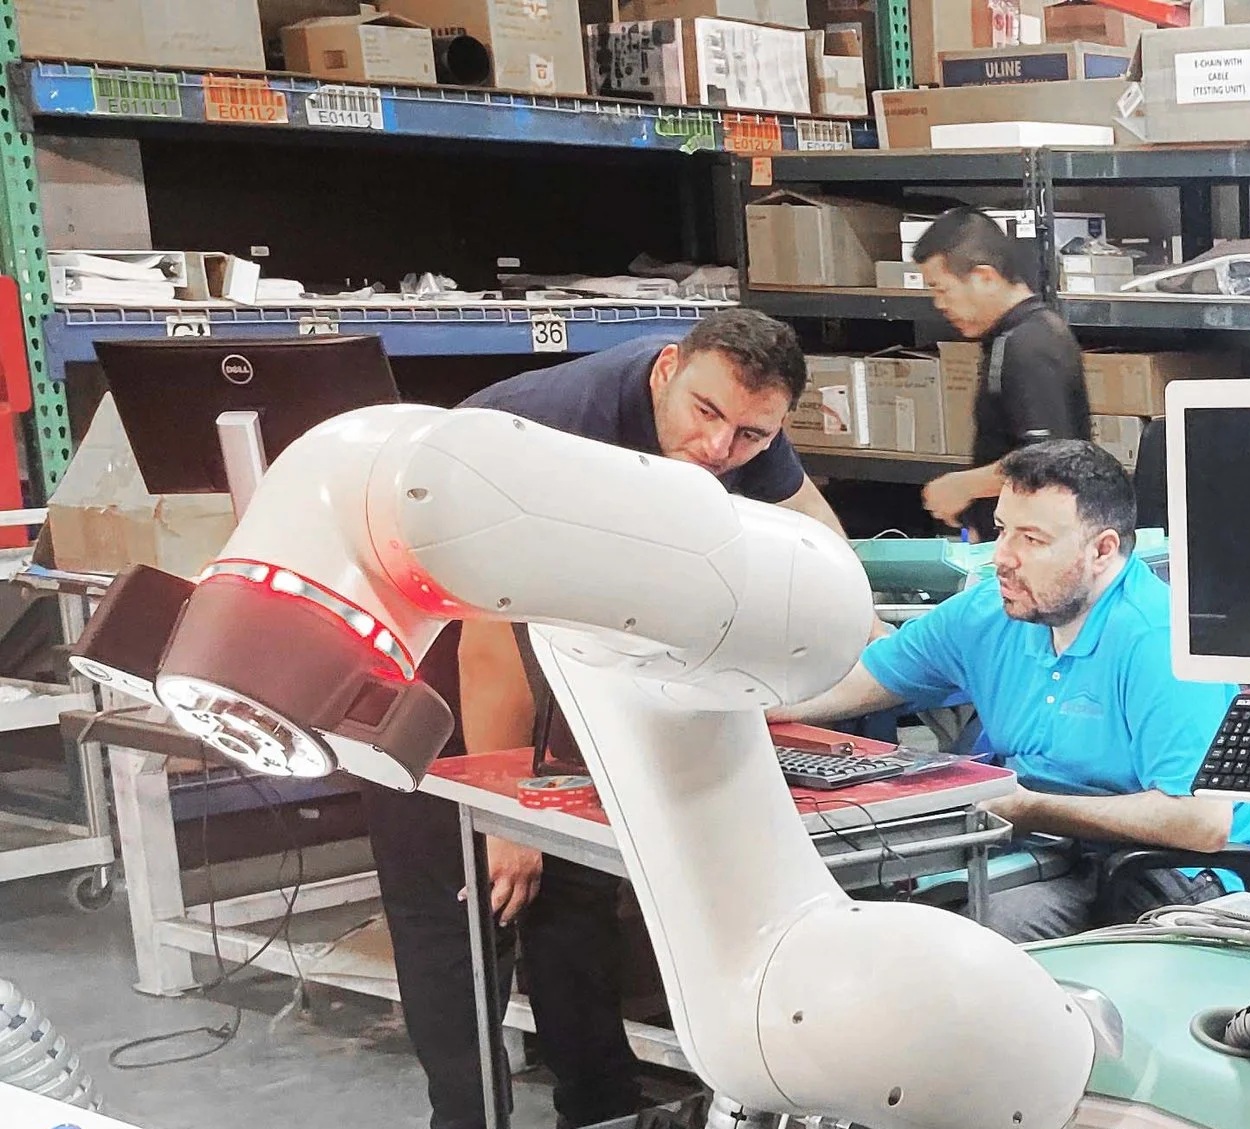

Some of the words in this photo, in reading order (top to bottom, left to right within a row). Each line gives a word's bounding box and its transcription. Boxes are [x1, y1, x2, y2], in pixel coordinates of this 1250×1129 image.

[985, 60, 1022, 78] ULINE
[1223, 57, 1242, 67] WITH
[1208, 71, 1229, 81] CABLE
[108, 98, 168, 115] E011L1
[218, 105, 276, 121] E011L2
[535, 321, 563, 344] 36
[225, 365, 250, 374] DELL
